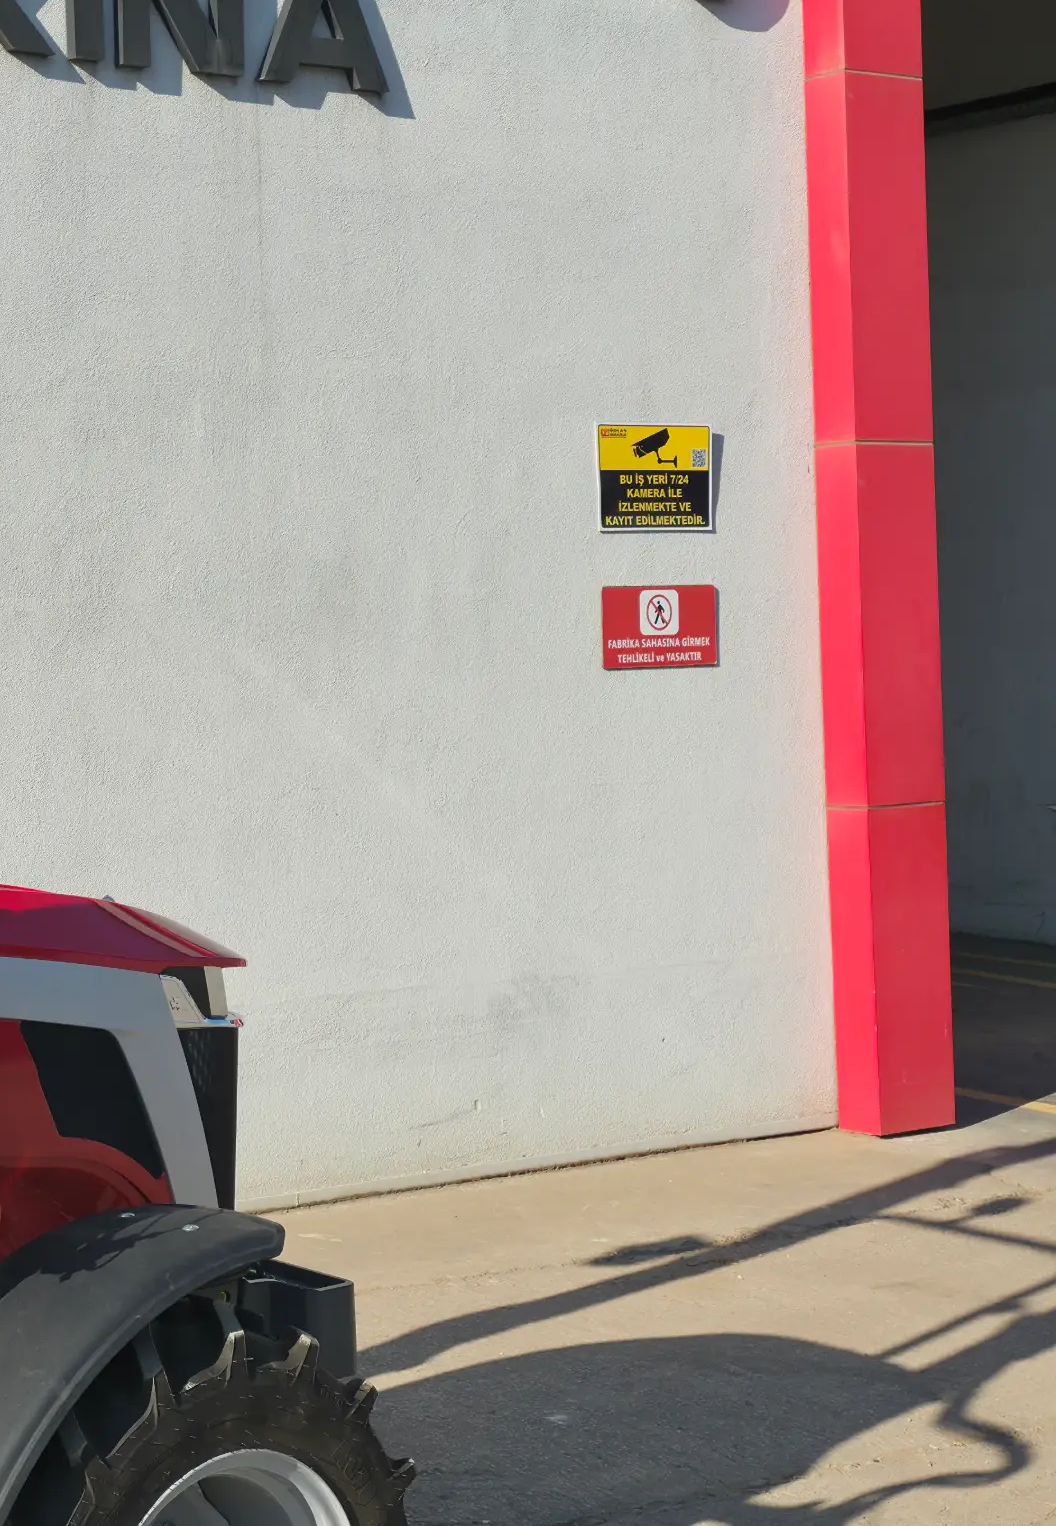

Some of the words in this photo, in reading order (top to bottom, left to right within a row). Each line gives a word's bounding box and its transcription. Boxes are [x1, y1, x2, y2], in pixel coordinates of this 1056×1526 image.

[619, 474, 633, 485] BU
[635, 473, 644, 486] İŞ
[646, 473, 668, 485] YERİ
[670, 474, 689, 485] 7/24
[627, 488, 666, 498] KAMERA
[668, 487, 683, 498] İLE
[618, 500, 677, 512] İZLENMEKTE
[679, 502, 691, 512] VE
[605, 515, 633, 526] KAYIT
[635, 513, 706, 526] EDİLMEKTEDİR.
[607, 637, 640, 649] FABRİKA
[641, 638, 680, 648] SAHASINA
[681, 635, 711, 647] GİRMEK
[617, 651, 655, 663] TEHLİKELİ
[656, 654, 665, 662] ve
[666, 651, 702, 662] YASAKTIR
